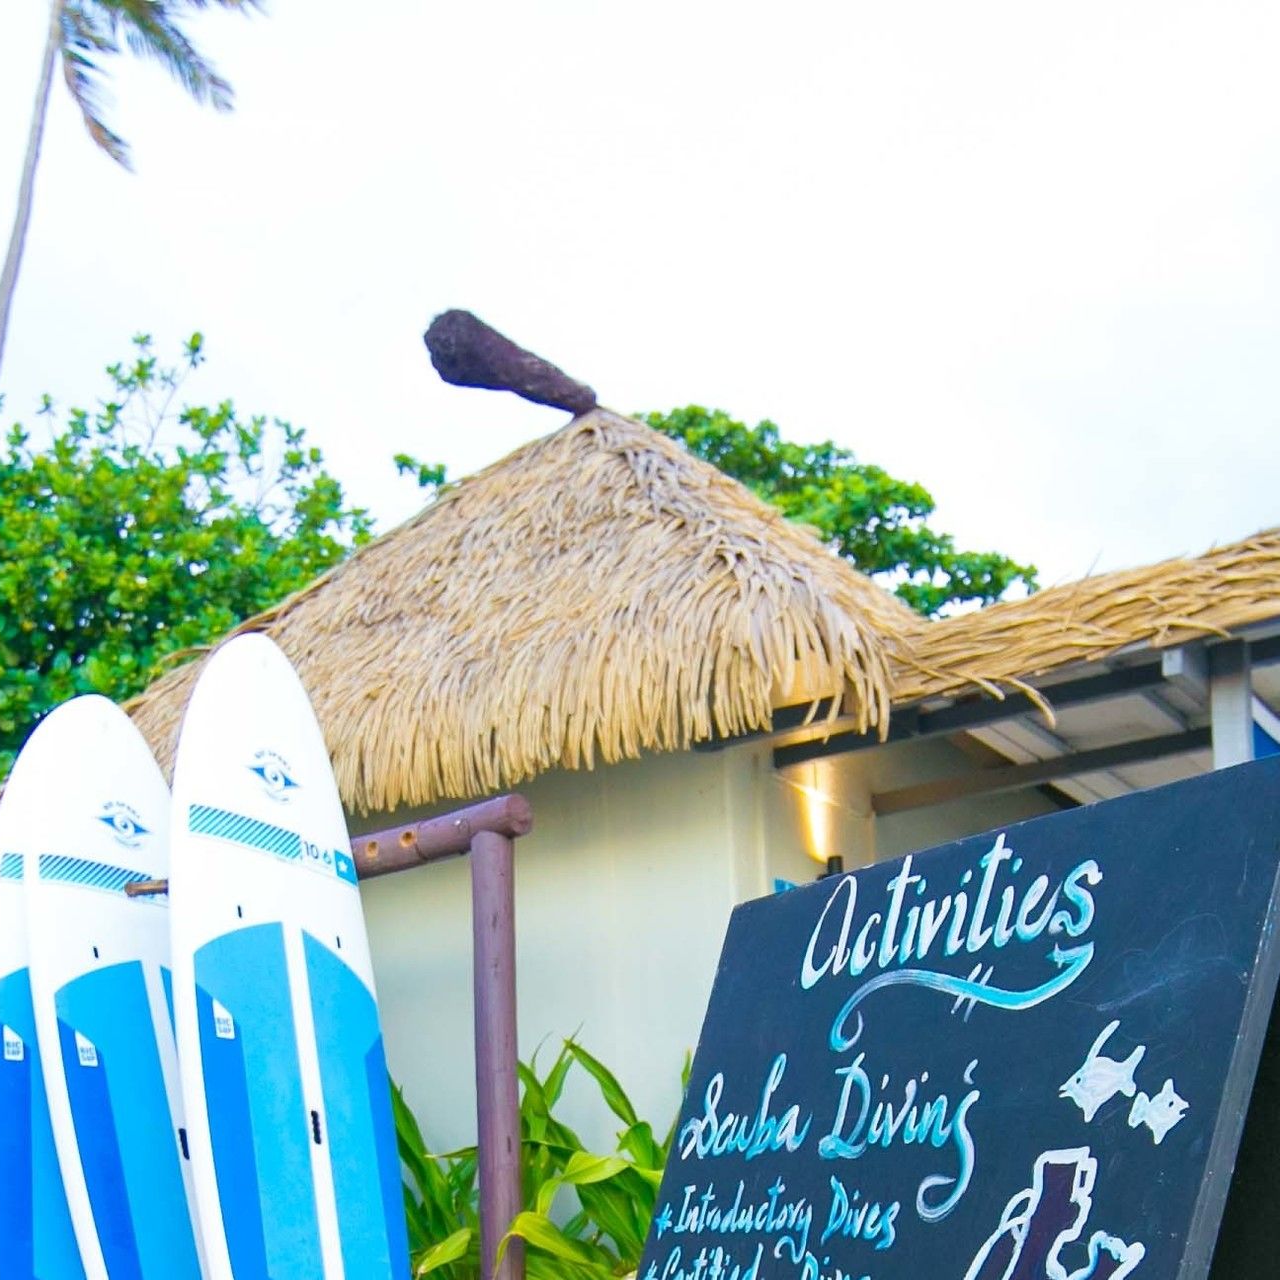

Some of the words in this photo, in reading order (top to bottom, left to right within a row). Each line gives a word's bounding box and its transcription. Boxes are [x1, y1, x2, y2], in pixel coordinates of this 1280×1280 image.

[800, 833, 1103, 989] Activities
[678, 1052, 812, 1162] Scuba
[818, 1051, 980, 1222] Diving
[673, 1175, 812, 1263] Introductory
[820, 1175, 900, 1250] Dives
